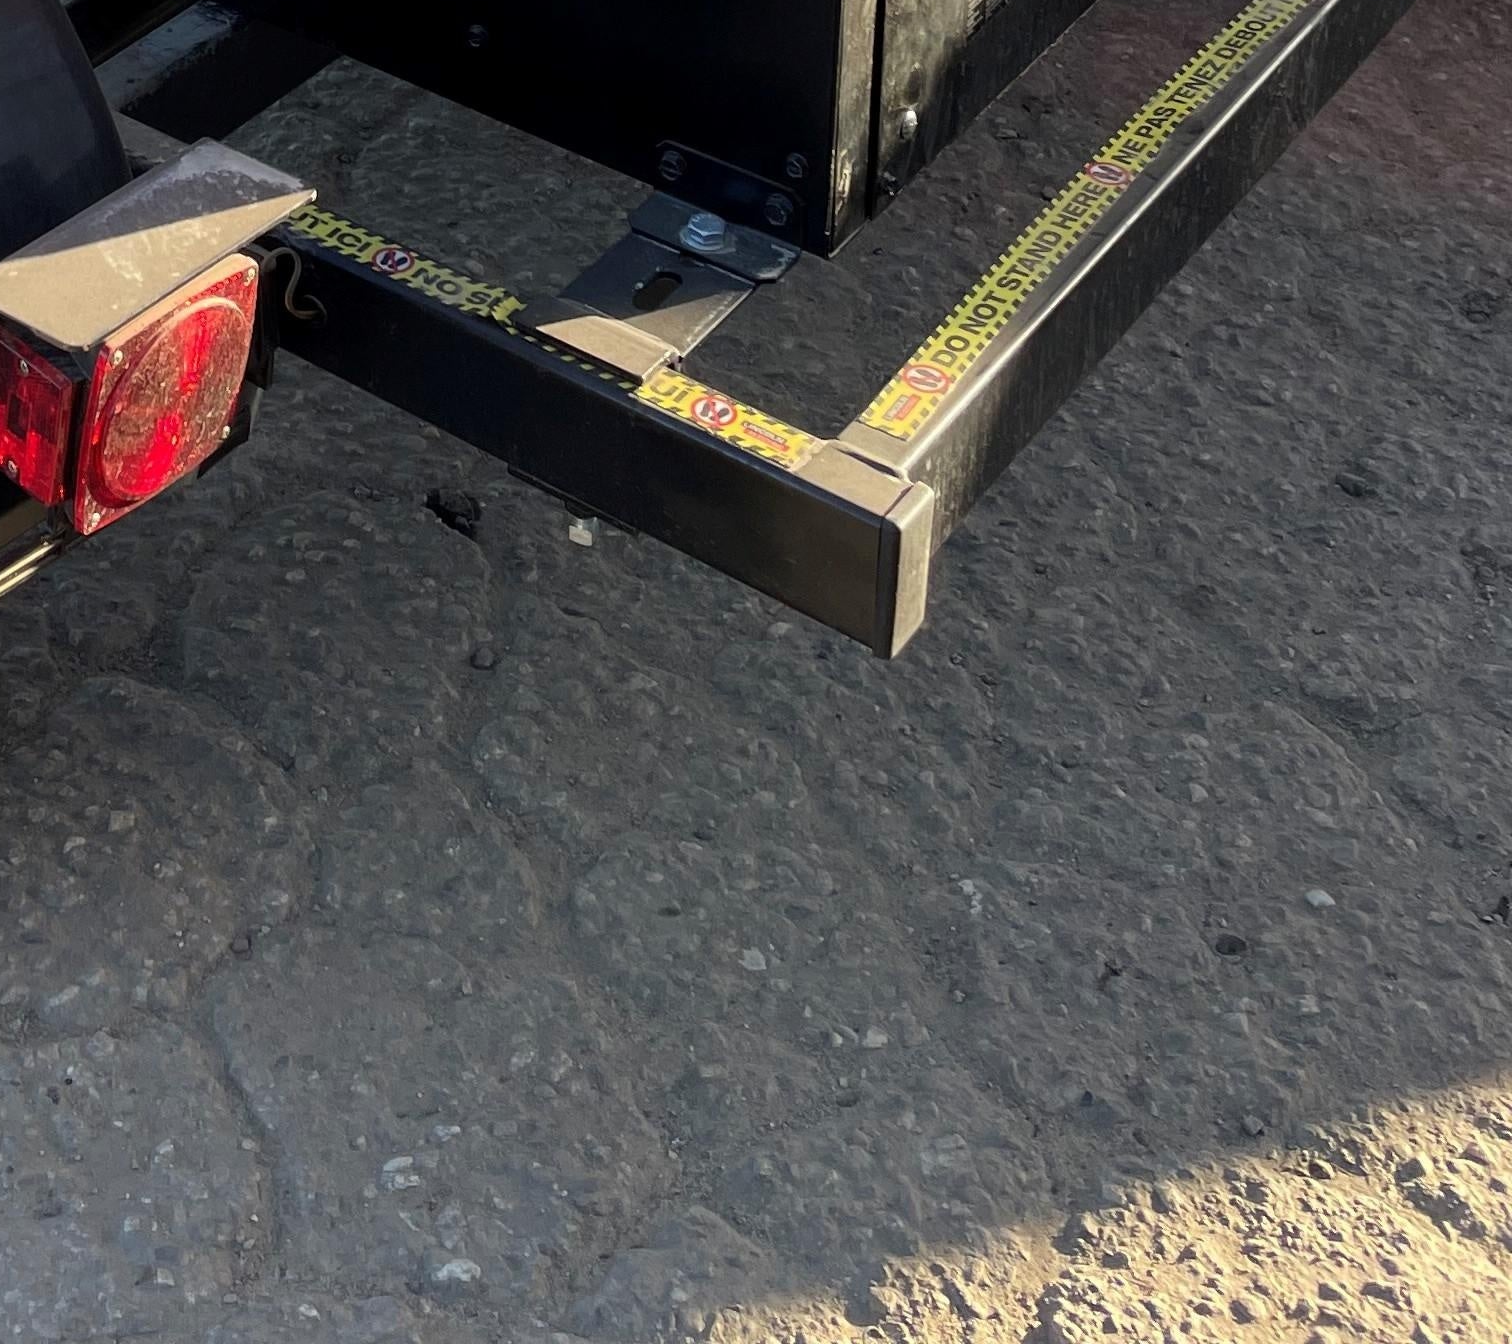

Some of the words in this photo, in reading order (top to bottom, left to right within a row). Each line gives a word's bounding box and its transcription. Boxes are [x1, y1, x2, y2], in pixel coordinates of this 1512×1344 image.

[327, 226, 373, 253] ICI
[410, 267, 464, 296] NO
[932, 334, 970, 368] DO
[958, 290, 1008, 337] NOT
[996, 230, 1062, 293] STAND
[1057, 181, 1108, 230] HERE
[1110, 138, 1148, 166] NE
[1140, 105, 1177, 141] PAS
[1168, 59, 1225, 108] TENEZ
[1215, 3, 1283, 60] DEBOUT
